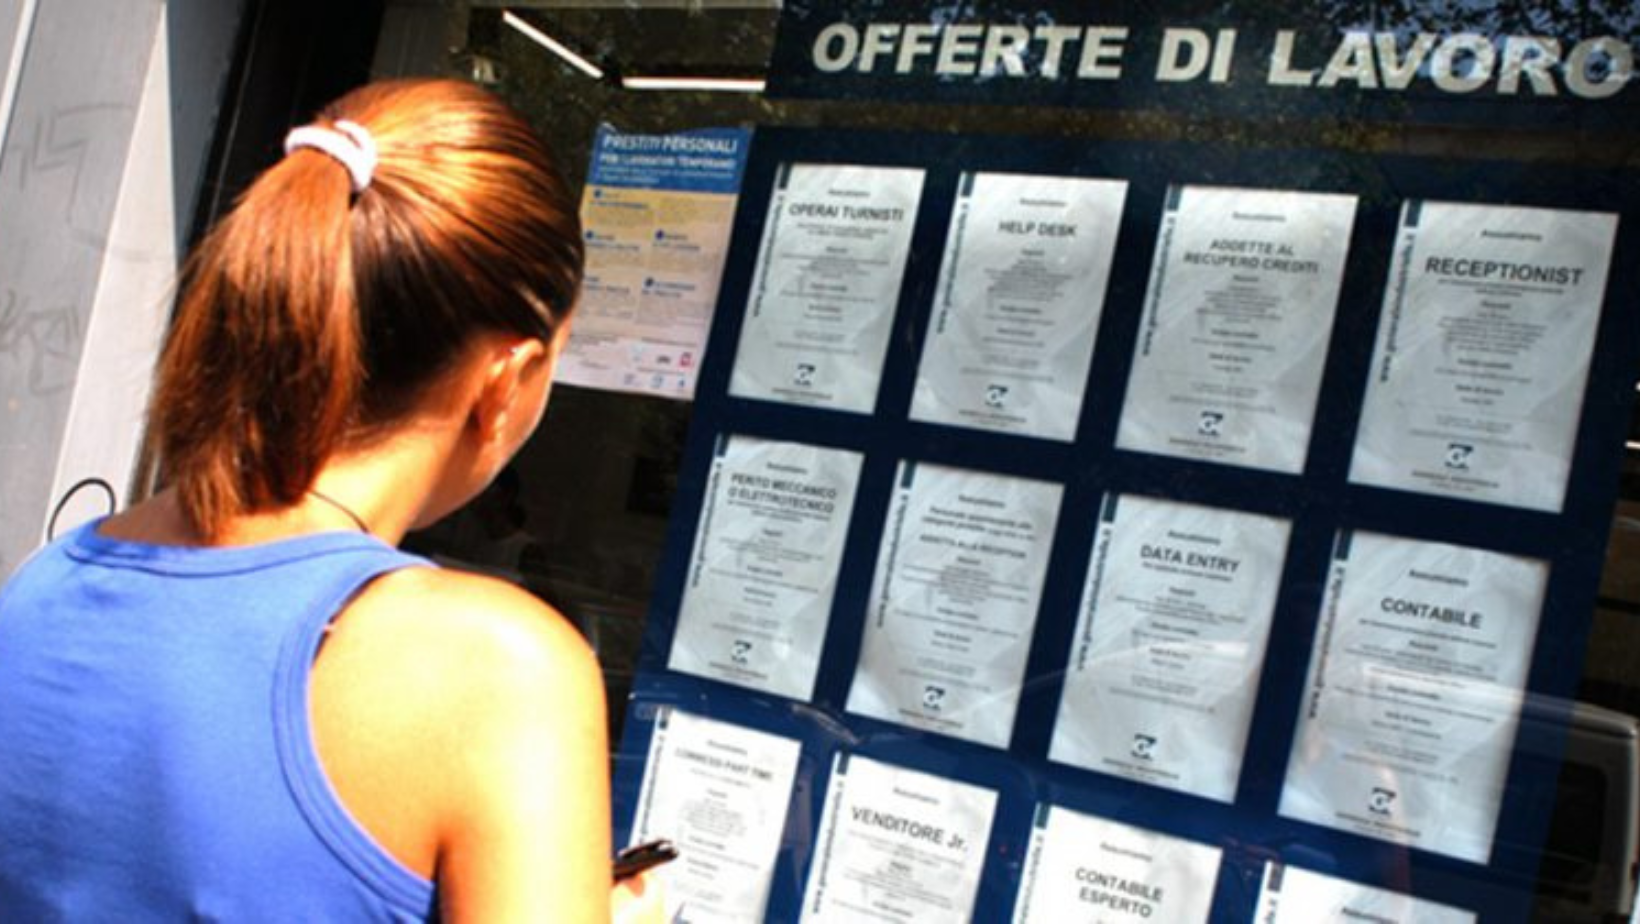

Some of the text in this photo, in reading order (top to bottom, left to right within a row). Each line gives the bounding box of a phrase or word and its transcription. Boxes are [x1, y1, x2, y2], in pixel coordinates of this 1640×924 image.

[811, 23, 1636, 98] OFFERTE DI LAVORO
[602, 134, 738, 153] PRESTITI PERSONALI
[789, 202, 904, 222] OPERAI TURNISTI
[998, 220, 1077, 237] HELP DESK
[1183, 251, 1320, 274] RECUPERO CREDITI
[1210, 239, 1294, 257] ADDETTE AL
[1425, 255, 1585, 286] RECEPTIONIST
[730, 472, 838, 500] PERITO MECCANICO
[738, 488, 836, 514] ELETTROTECNICO
[1139, 544, 1184, 565] DATA
[1185, 551, 1241, 574] ENTRY
[1380, 597, 1483, 629] CONTABILE
[851, 806, 945, 846] VENDITORE
[946, 833, 969, 853] Jr.
[1074, 867, 1165, 905] CONTABILE
[1078, 885, 1153, 919] ESPERTO
